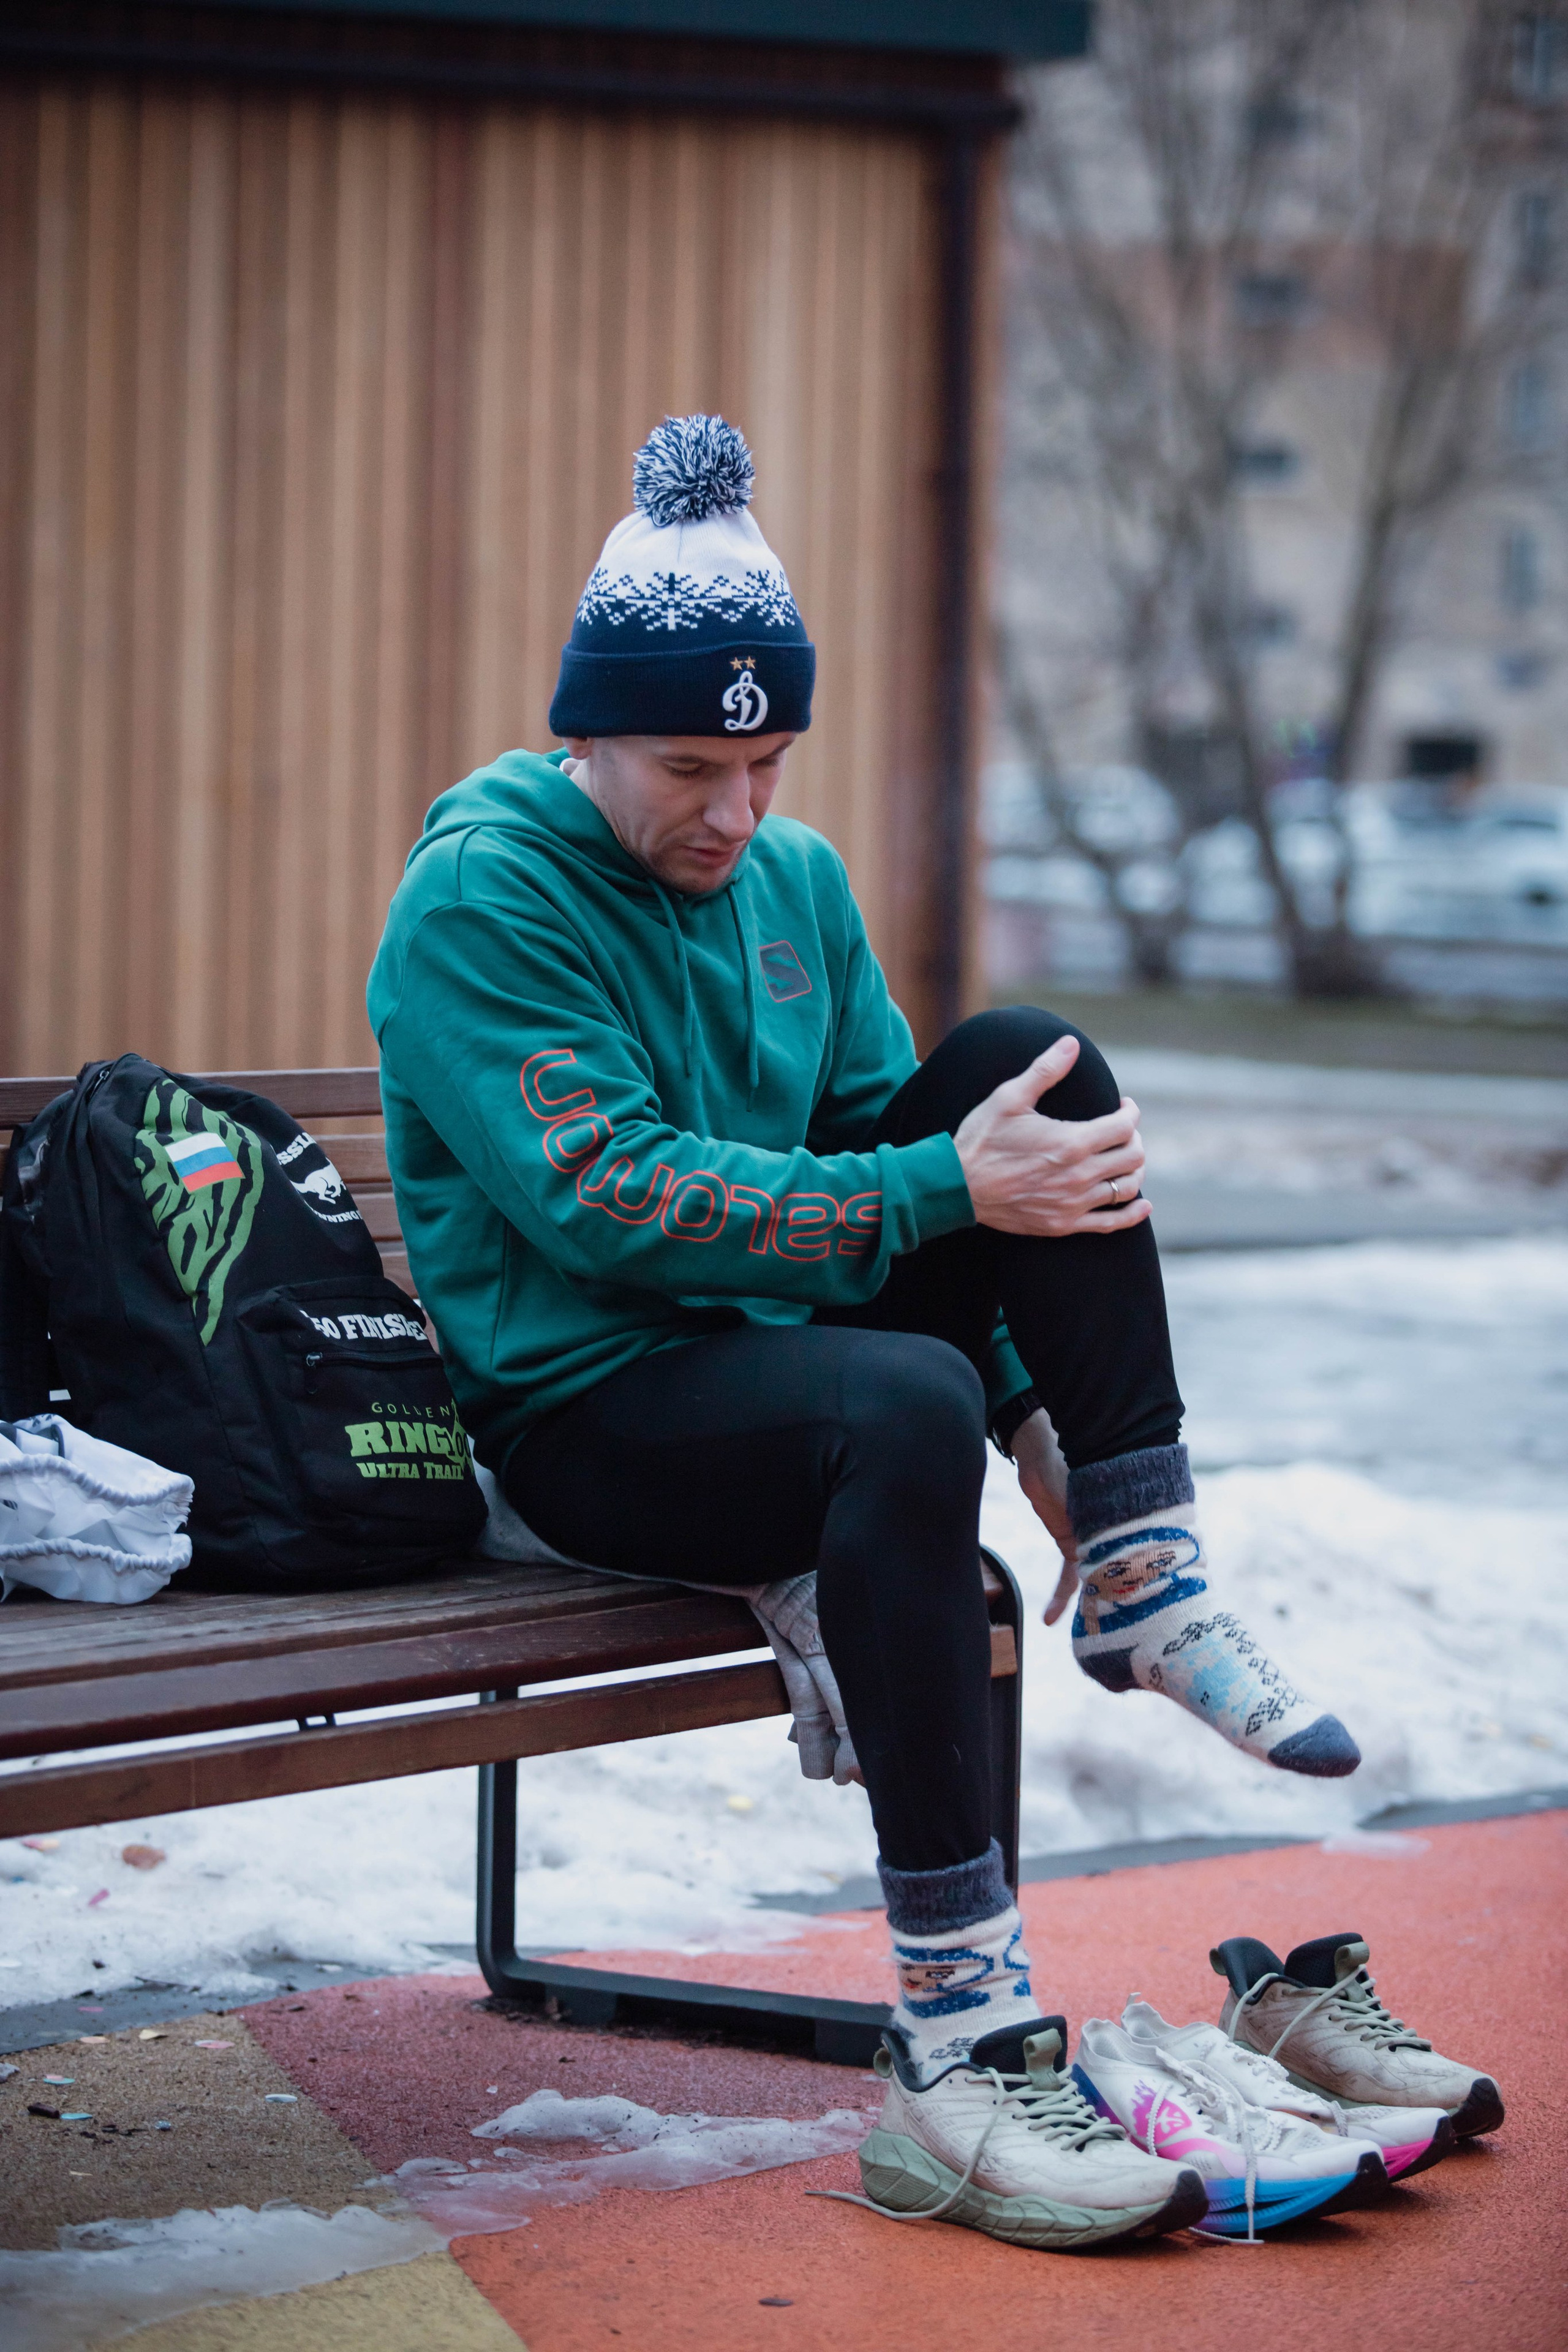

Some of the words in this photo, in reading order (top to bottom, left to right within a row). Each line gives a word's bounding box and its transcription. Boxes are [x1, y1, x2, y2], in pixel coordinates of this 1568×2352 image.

[371, 1402, 450, 1417] GOLDEN
[356, 1462, 420, 1479] ULTRA
[423, 1461, 464, 1480] TRAIL
